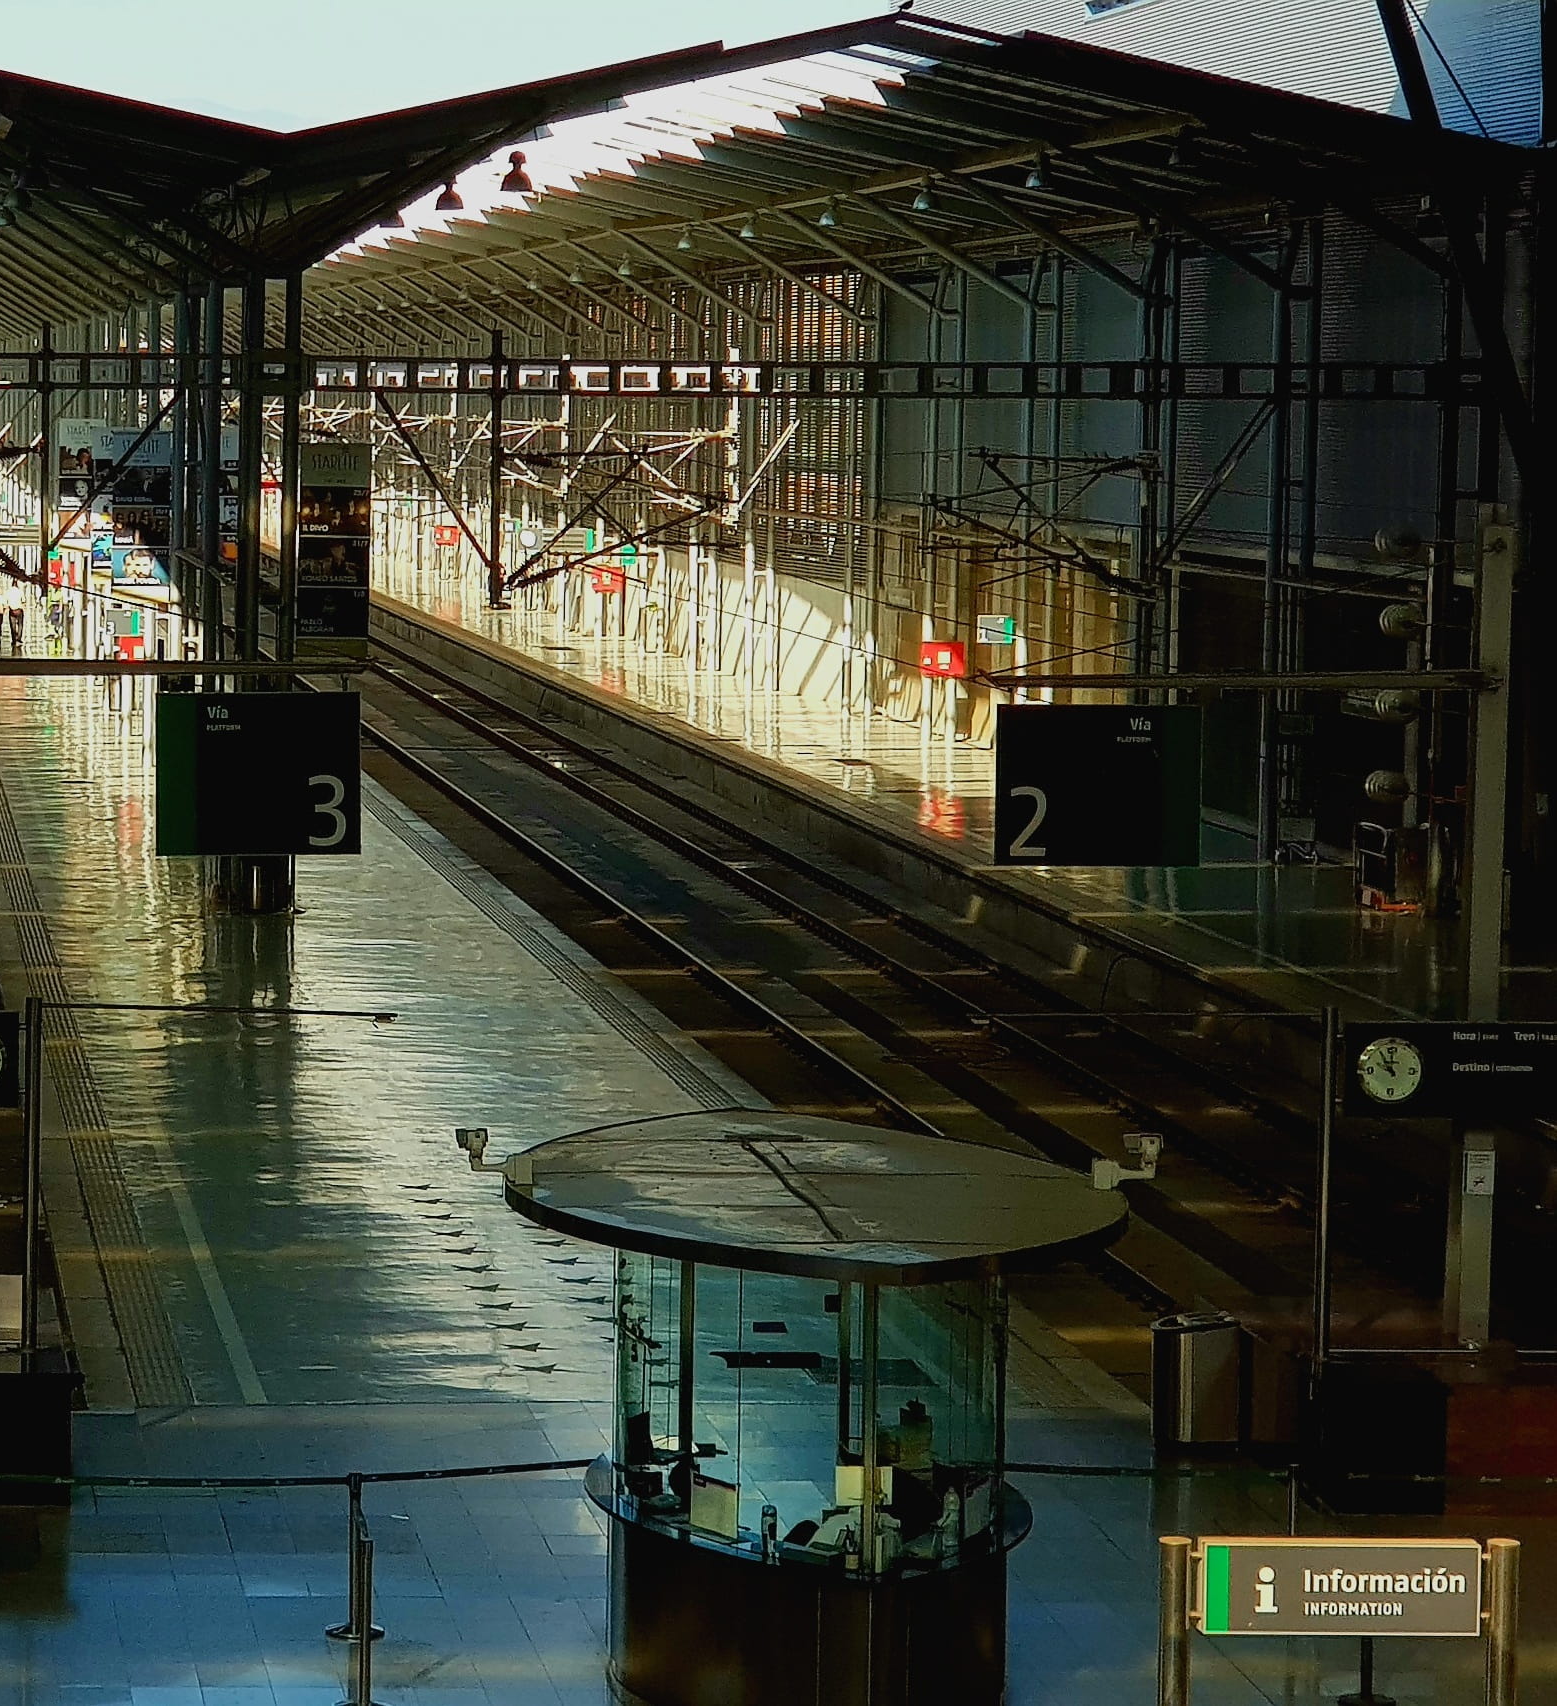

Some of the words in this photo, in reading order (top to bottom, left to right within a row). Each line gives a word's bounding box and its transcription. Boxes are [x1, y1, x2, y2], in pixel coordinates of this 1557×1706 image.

[206, 704, 229, 719] Vía
[1129, 716, 1151, 731] Vía
[308, 774, 347, 847] 3
[1009, 785, 1047, 857] 2
[1452, 1031, 1477, 1041] Hora
[1513, 1031, 1536, 1041] Tren
[1451, 1062, 1490, 1072] Destino
[1303, 1567, 1466, 1594] Información
[1303, 1602, 1404, 1616] INFORMATION
